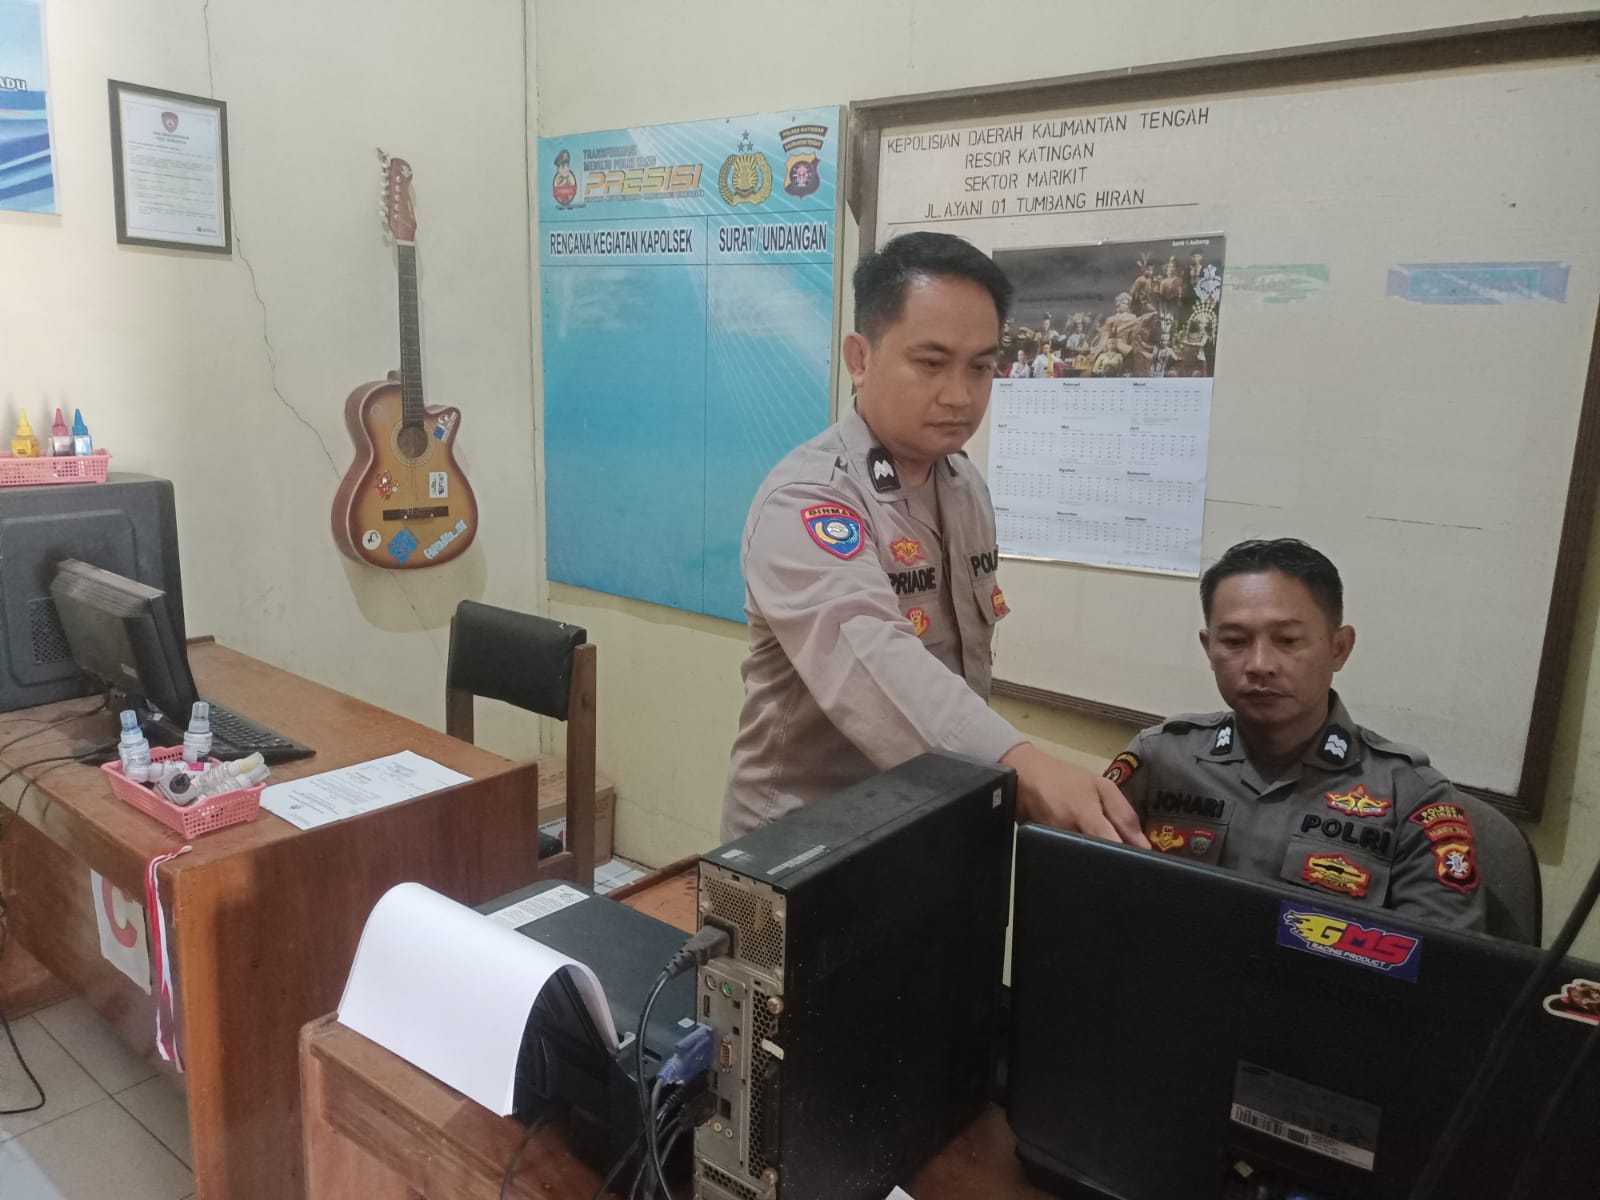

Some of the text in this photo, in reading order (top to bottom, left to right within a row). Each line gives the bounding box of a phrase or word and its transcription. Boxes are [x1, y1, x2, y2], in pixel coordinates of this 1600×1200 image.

[887, 107, 1209, 153] KEPOLISIAN DAERAH KALIMANTAN TENGAH
[965, 142, 1095, 169] RESOR KATINGAN
[584, 163, 703, 197] PRESISI
[964, 166, 1089, 192] SEKTOR MARIKIT
[924, 203, 941, 219] JL.
[991, 199, 1007, 215] 01
[1016, 192, 1087, 213] TUMBANG
[1095, 188, 1145, 208] HIRAN
[550, 228, 693, 255] RENCANA KEGIATAN KAPOLSEK
[719, 226, 754, 252] SURAT
[762, 223, 827, 251] UNDANGAN
[970, 544, 999, 577] POL
[1153, 790, 1225, 819] JOHARI
[1301, 814, 1392, 853] POLRI
[1290, 911, 1418, 965] GMS
[1311, 942, 1387, 969] RACING PRODUCT
